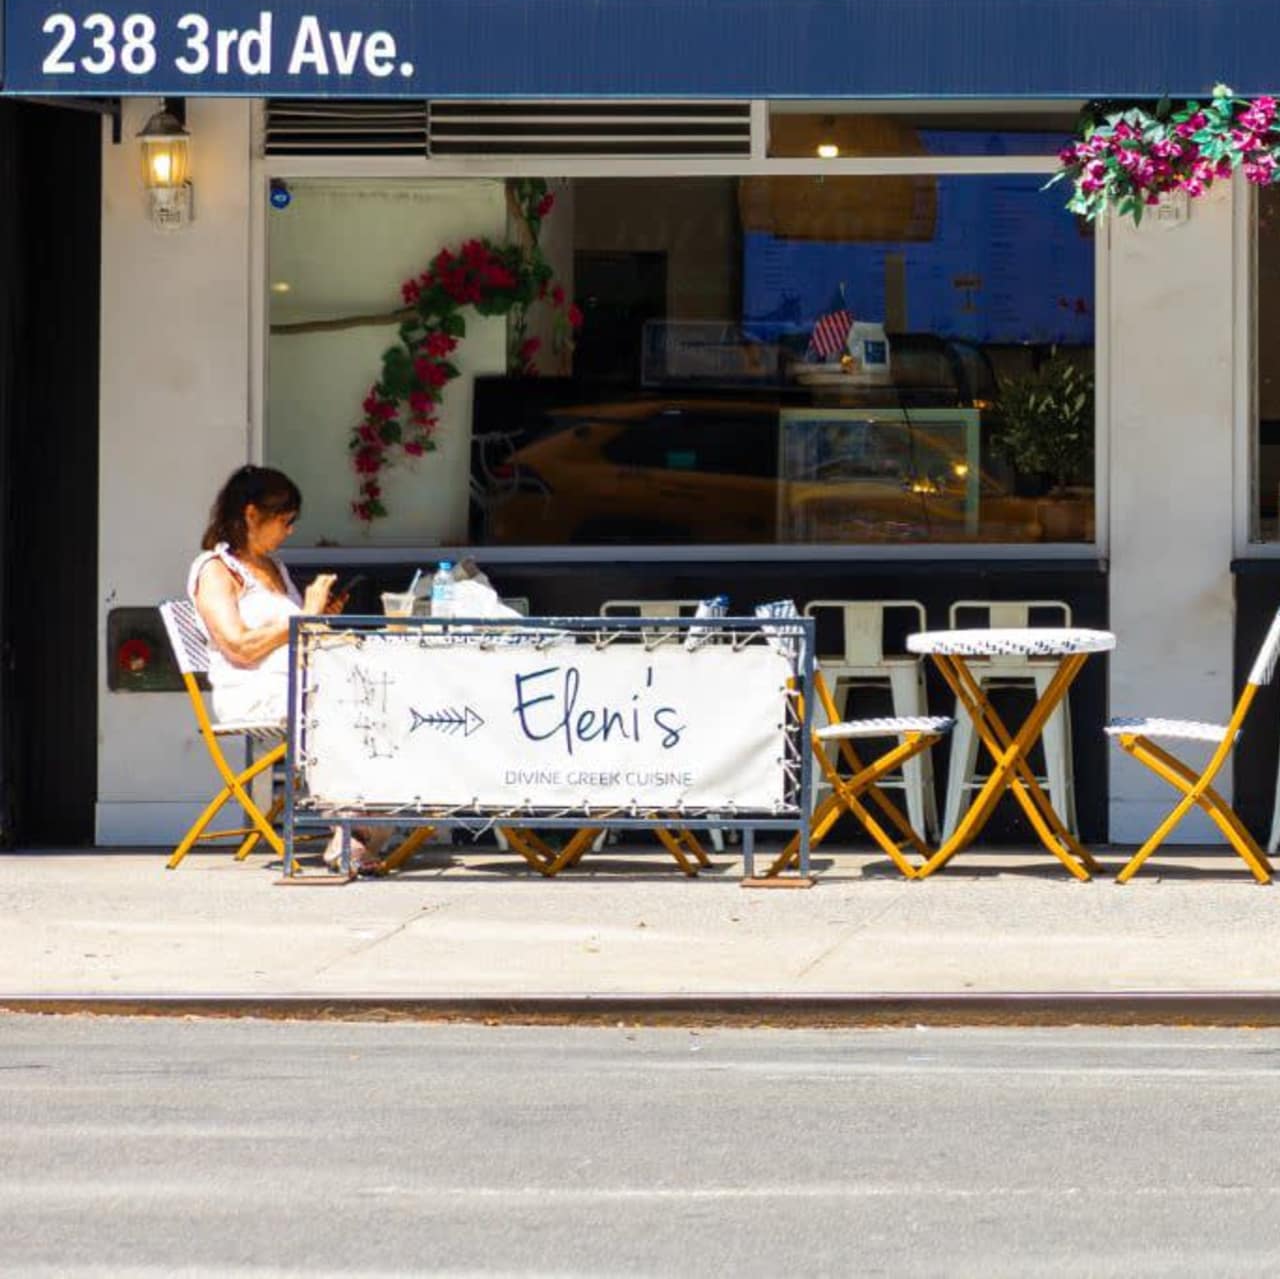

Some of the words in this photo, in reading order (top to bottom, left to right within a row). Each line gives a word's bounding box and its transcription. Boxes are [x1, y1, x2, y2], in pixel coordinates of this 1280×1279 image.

[42, 14, 157, 75] 238
[175, 11, 273, 76] 3rd
[287, 15, 414, 77] Ave.
[513, 666, 686, 755] Eleni's
[505, 770, 560, 785] DIVINE
[567, 770, 620, 786] GREEK
[625, 771, 692, 786] CUISINE
